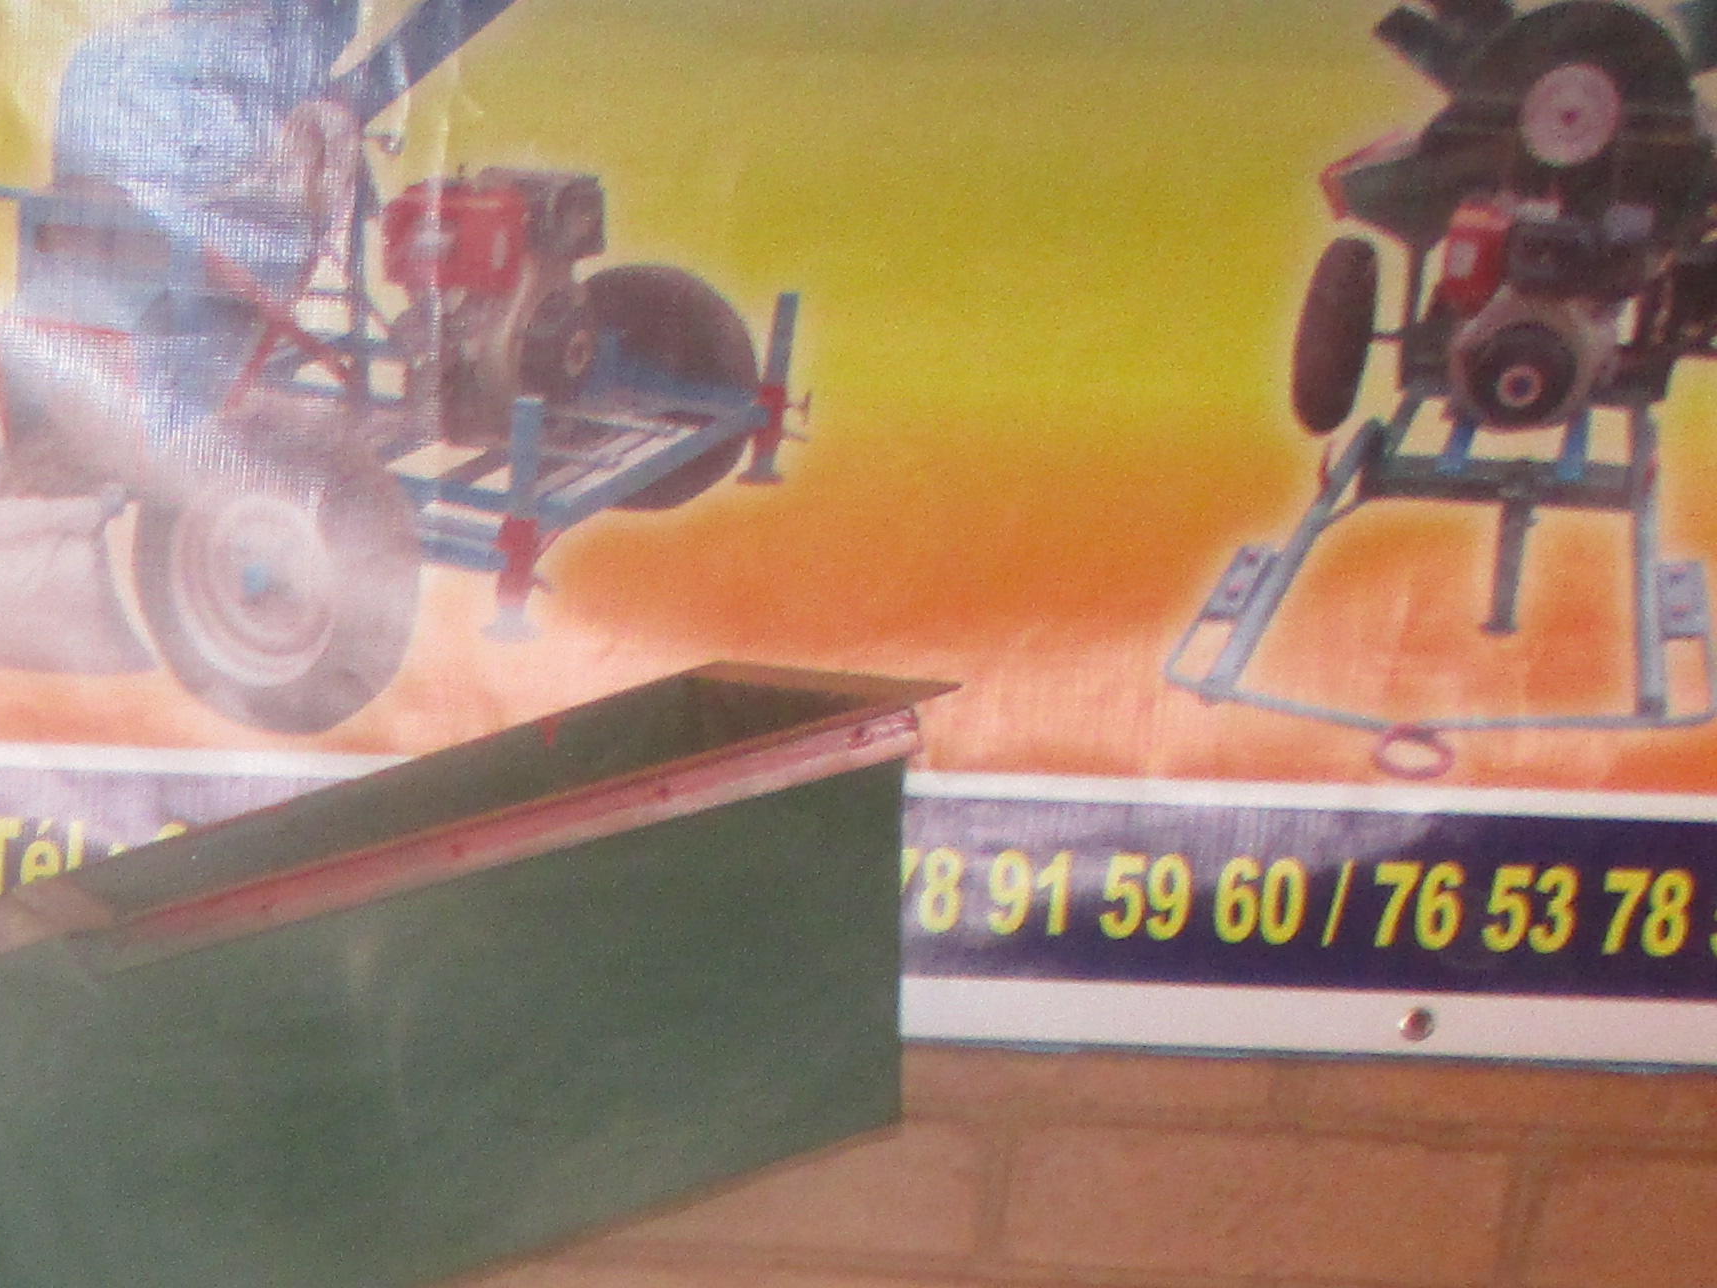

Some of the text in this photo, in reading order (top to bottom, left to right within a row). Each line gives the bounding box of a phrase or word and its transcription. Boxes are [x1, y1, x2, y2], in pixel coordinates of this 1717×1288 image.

[986, 849, 1073, 936] 91
[1098, 851, 1193, 941] 59
[1214, 856, 1305, 946] 60
[1321, 858, 1357, 948] /
[1373, 861, 1465, 949] 76
[1481, 864, 1579, 955] 53
[1601, 867, 1695, 957] 78
